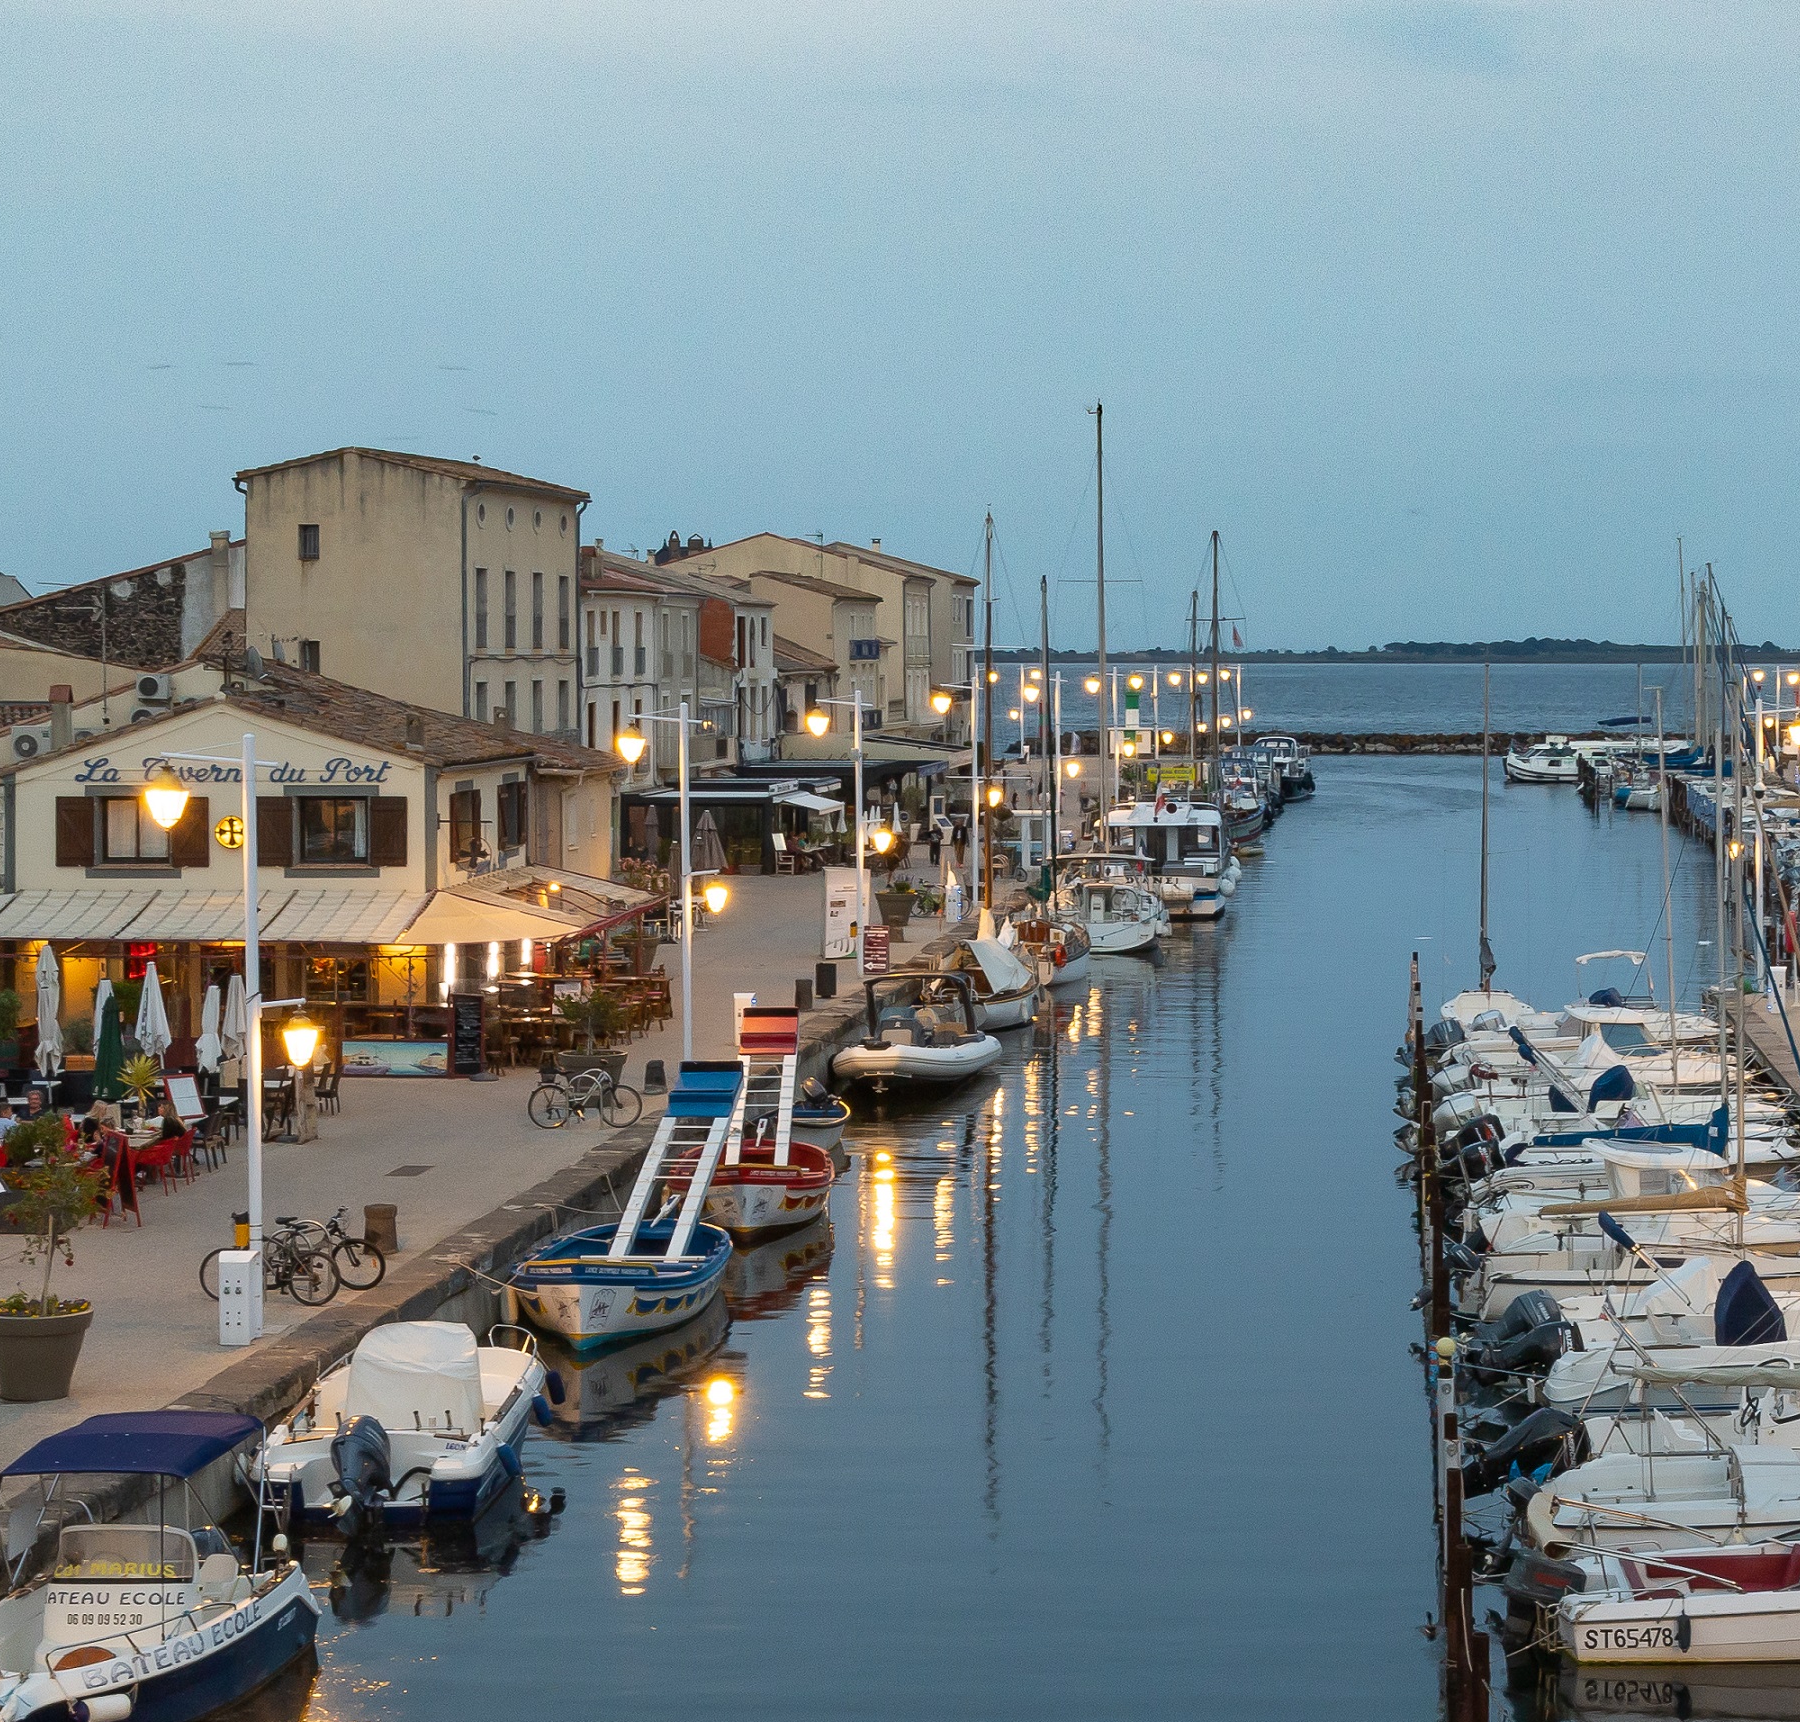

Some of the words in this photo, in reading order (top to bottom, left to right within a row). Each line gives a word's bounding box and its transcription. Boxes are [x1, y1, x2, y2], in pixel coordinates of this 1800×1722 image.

[75, 757, 121, 783] La
[270, 761, 306, 783] du
[319, 757, 393, 784] Port
[90, 1561, 177, 1578] MARIUS
[47, 1591, 110, 1605] ATEAU
[119, 1591, 185, 1605] ECOLE
[67, 1613, 79, 1625] 06
[82, 1613, 94, 1625] 09
[97, 1613, 110, 1625] 09
[113, 1613, 126, 1625] 52
[129, 1613, 142, 1625] 30
[81, 1632, 205, 1690] BATEAU
[211, 1600, 263, 1647] ECOLE
[1584, 1627, 1681, 1650] ST65478
